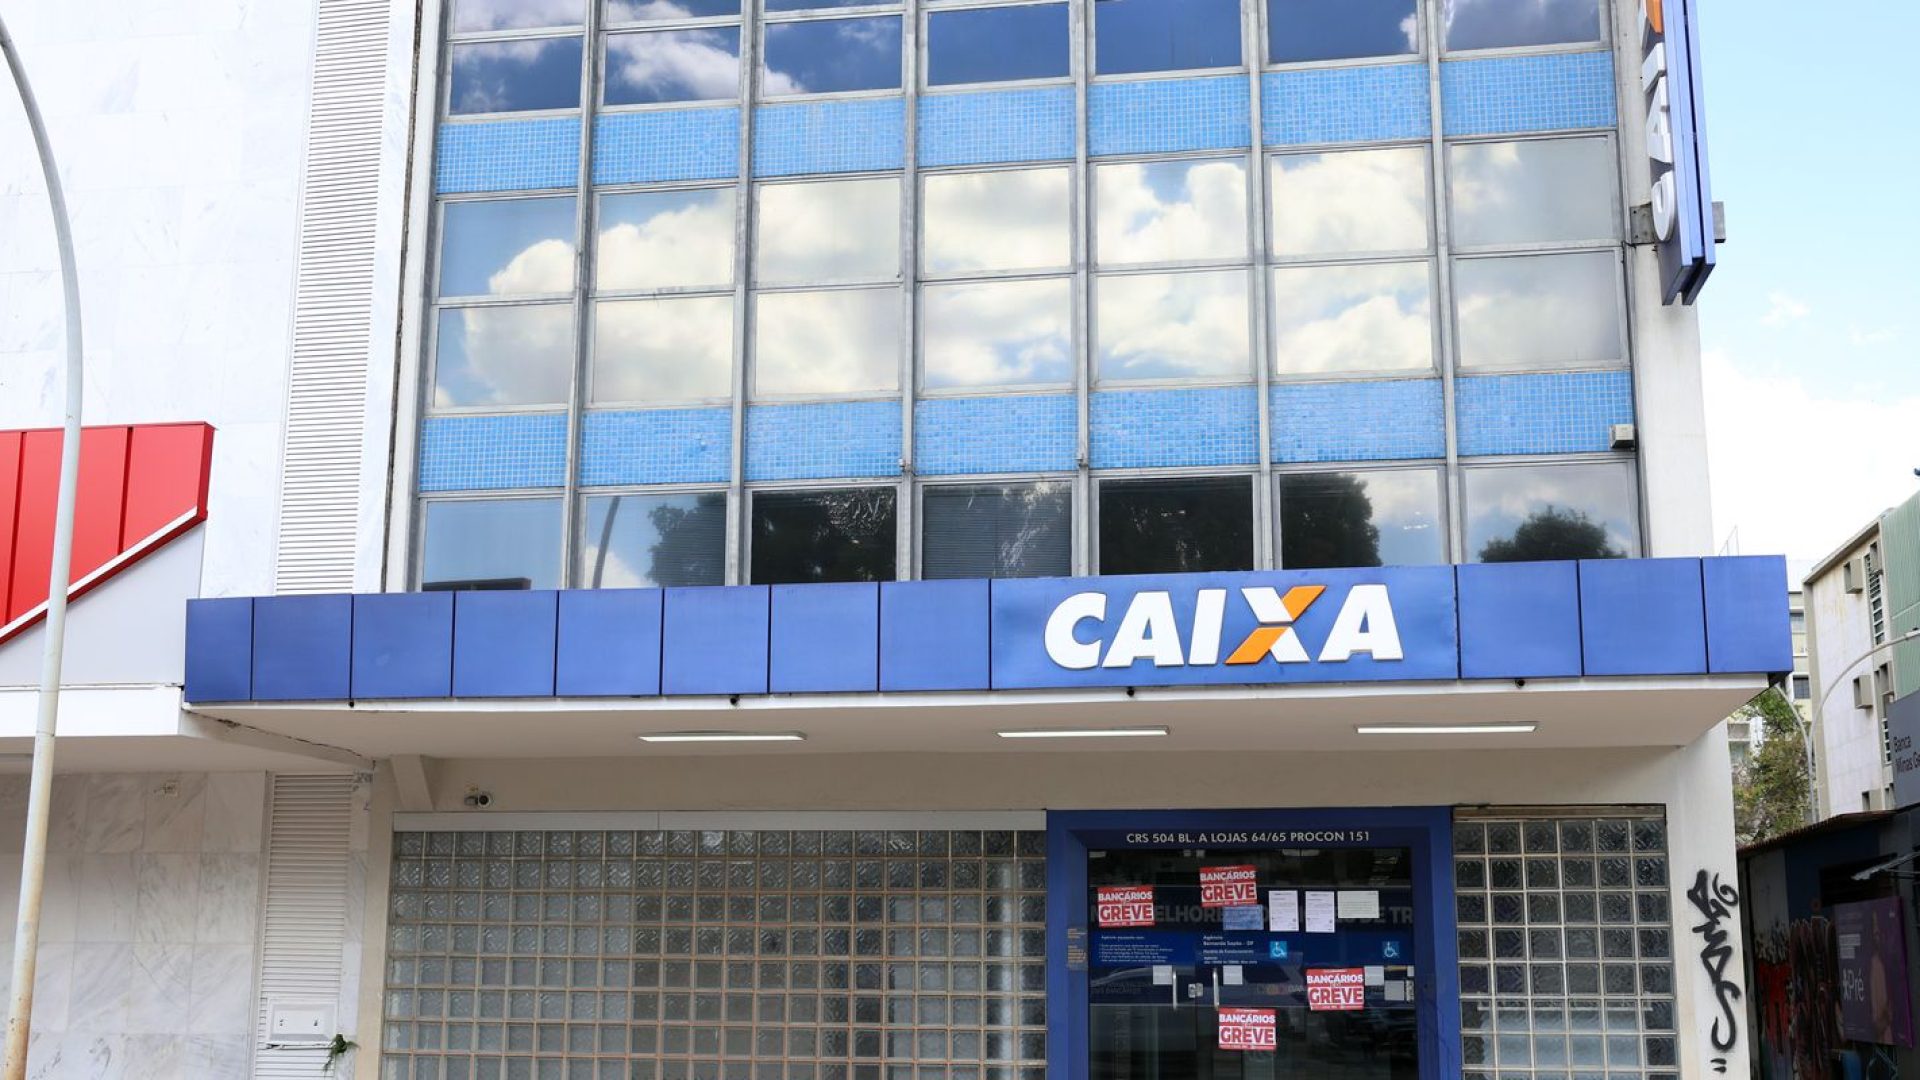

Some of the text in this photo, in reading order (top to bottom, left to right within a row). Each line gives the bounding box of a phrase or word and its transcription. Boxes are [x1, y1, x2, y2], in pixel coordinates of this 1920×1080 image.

[1044, 583, 1404, 669] CAIXA
[1126, 831, 1370, 843] CRS 504 BL. A LOJAS 64/65 PROCON 151
[1200, 871, 1256, 881] BANCÁRIOS
[1098, 891, 1153, 901] BANCÁRIOS
[1202, 884, 1255, 901] GREVE
[1100, 904, 1153, 921] GREVE
[1307, 973, 1363, 983] BANCÁRIOS
[1309, 988, 1363, 1003] GREVE
[1219, 1014, 1276, 1023] BANCÁRIOS
[1221, 1027, 1274, 1043] GREVE
